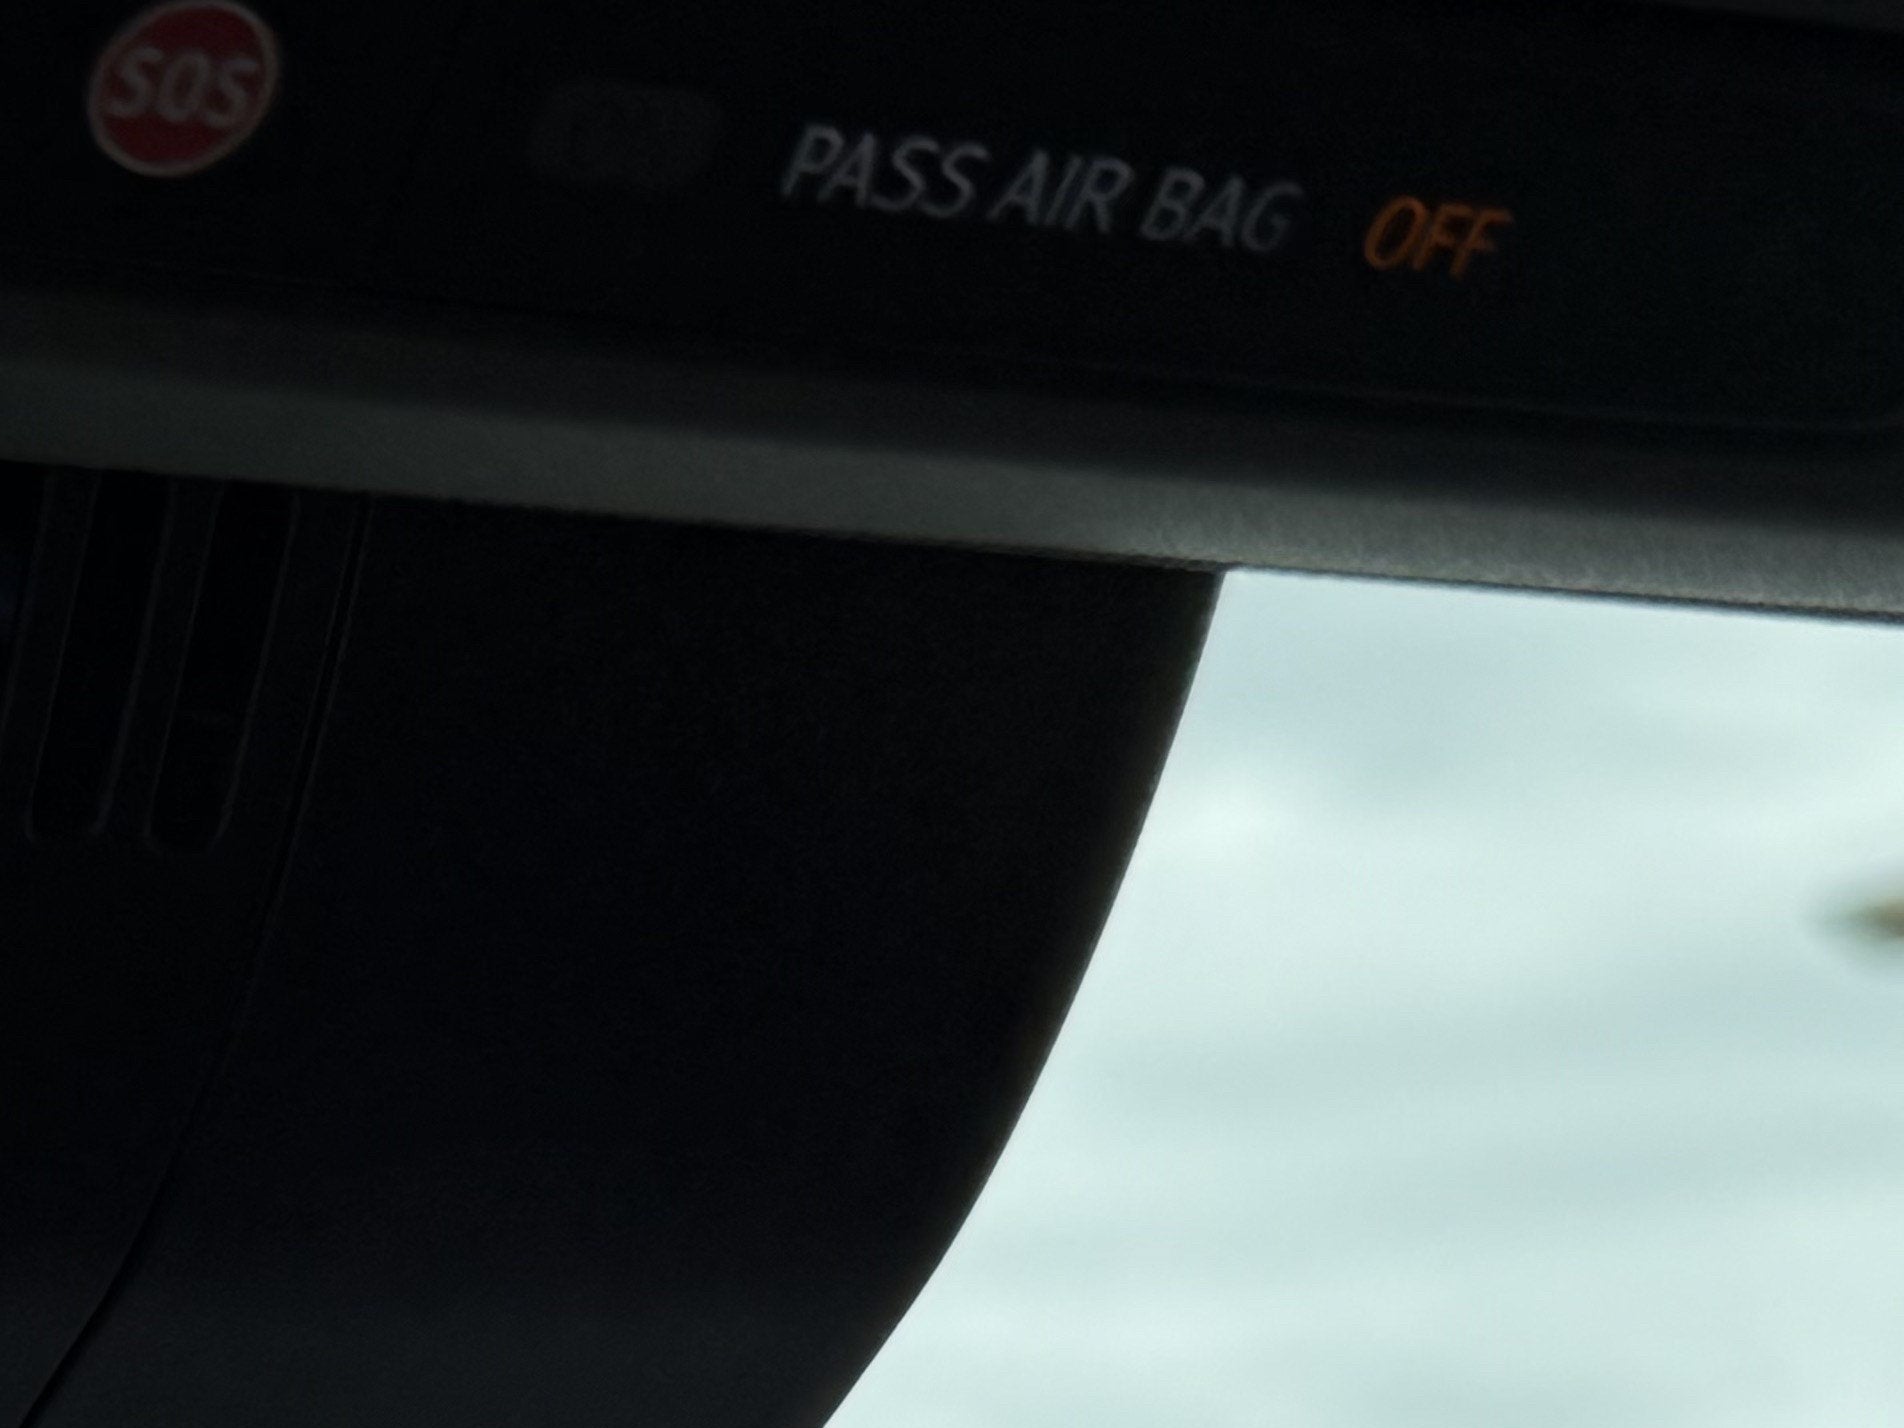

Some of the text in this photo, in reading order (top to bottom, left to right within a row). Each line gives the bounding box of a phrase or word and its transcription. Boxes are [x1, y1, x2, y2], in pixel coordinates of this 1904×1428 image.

[114, 44, 258, 126] SOS
[781, 122, 1516, 282] PASS AIR BAG OFF
